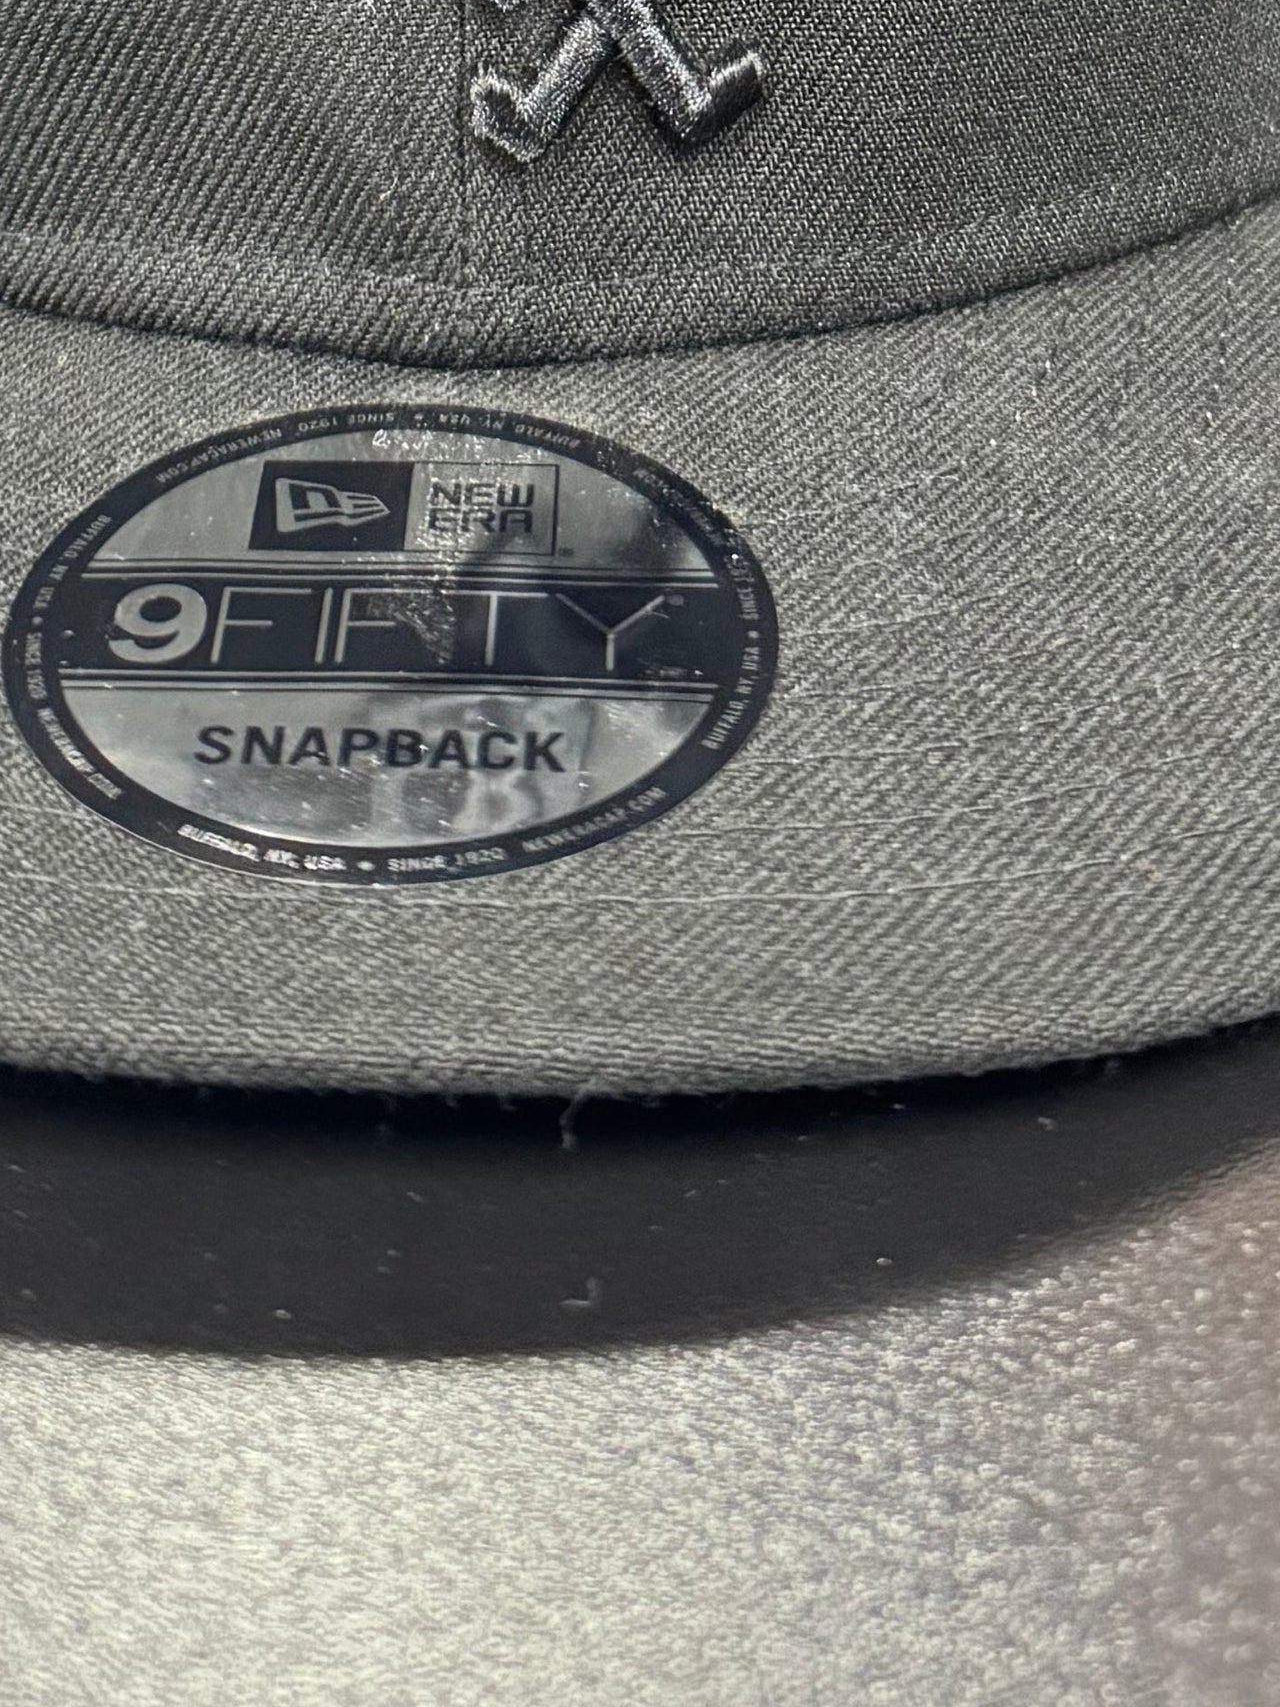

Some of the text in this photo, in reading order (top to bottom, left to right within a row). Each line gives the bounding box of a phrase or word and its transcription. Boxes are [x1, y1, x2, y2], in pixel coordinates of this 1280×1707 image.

[429, 483, 535, 508] NEW
[428, 508, 533, 534] ERA
[108, 583, 666, 672] 9FIFTY
[194, 725, 567, 773] SNAPBACK
